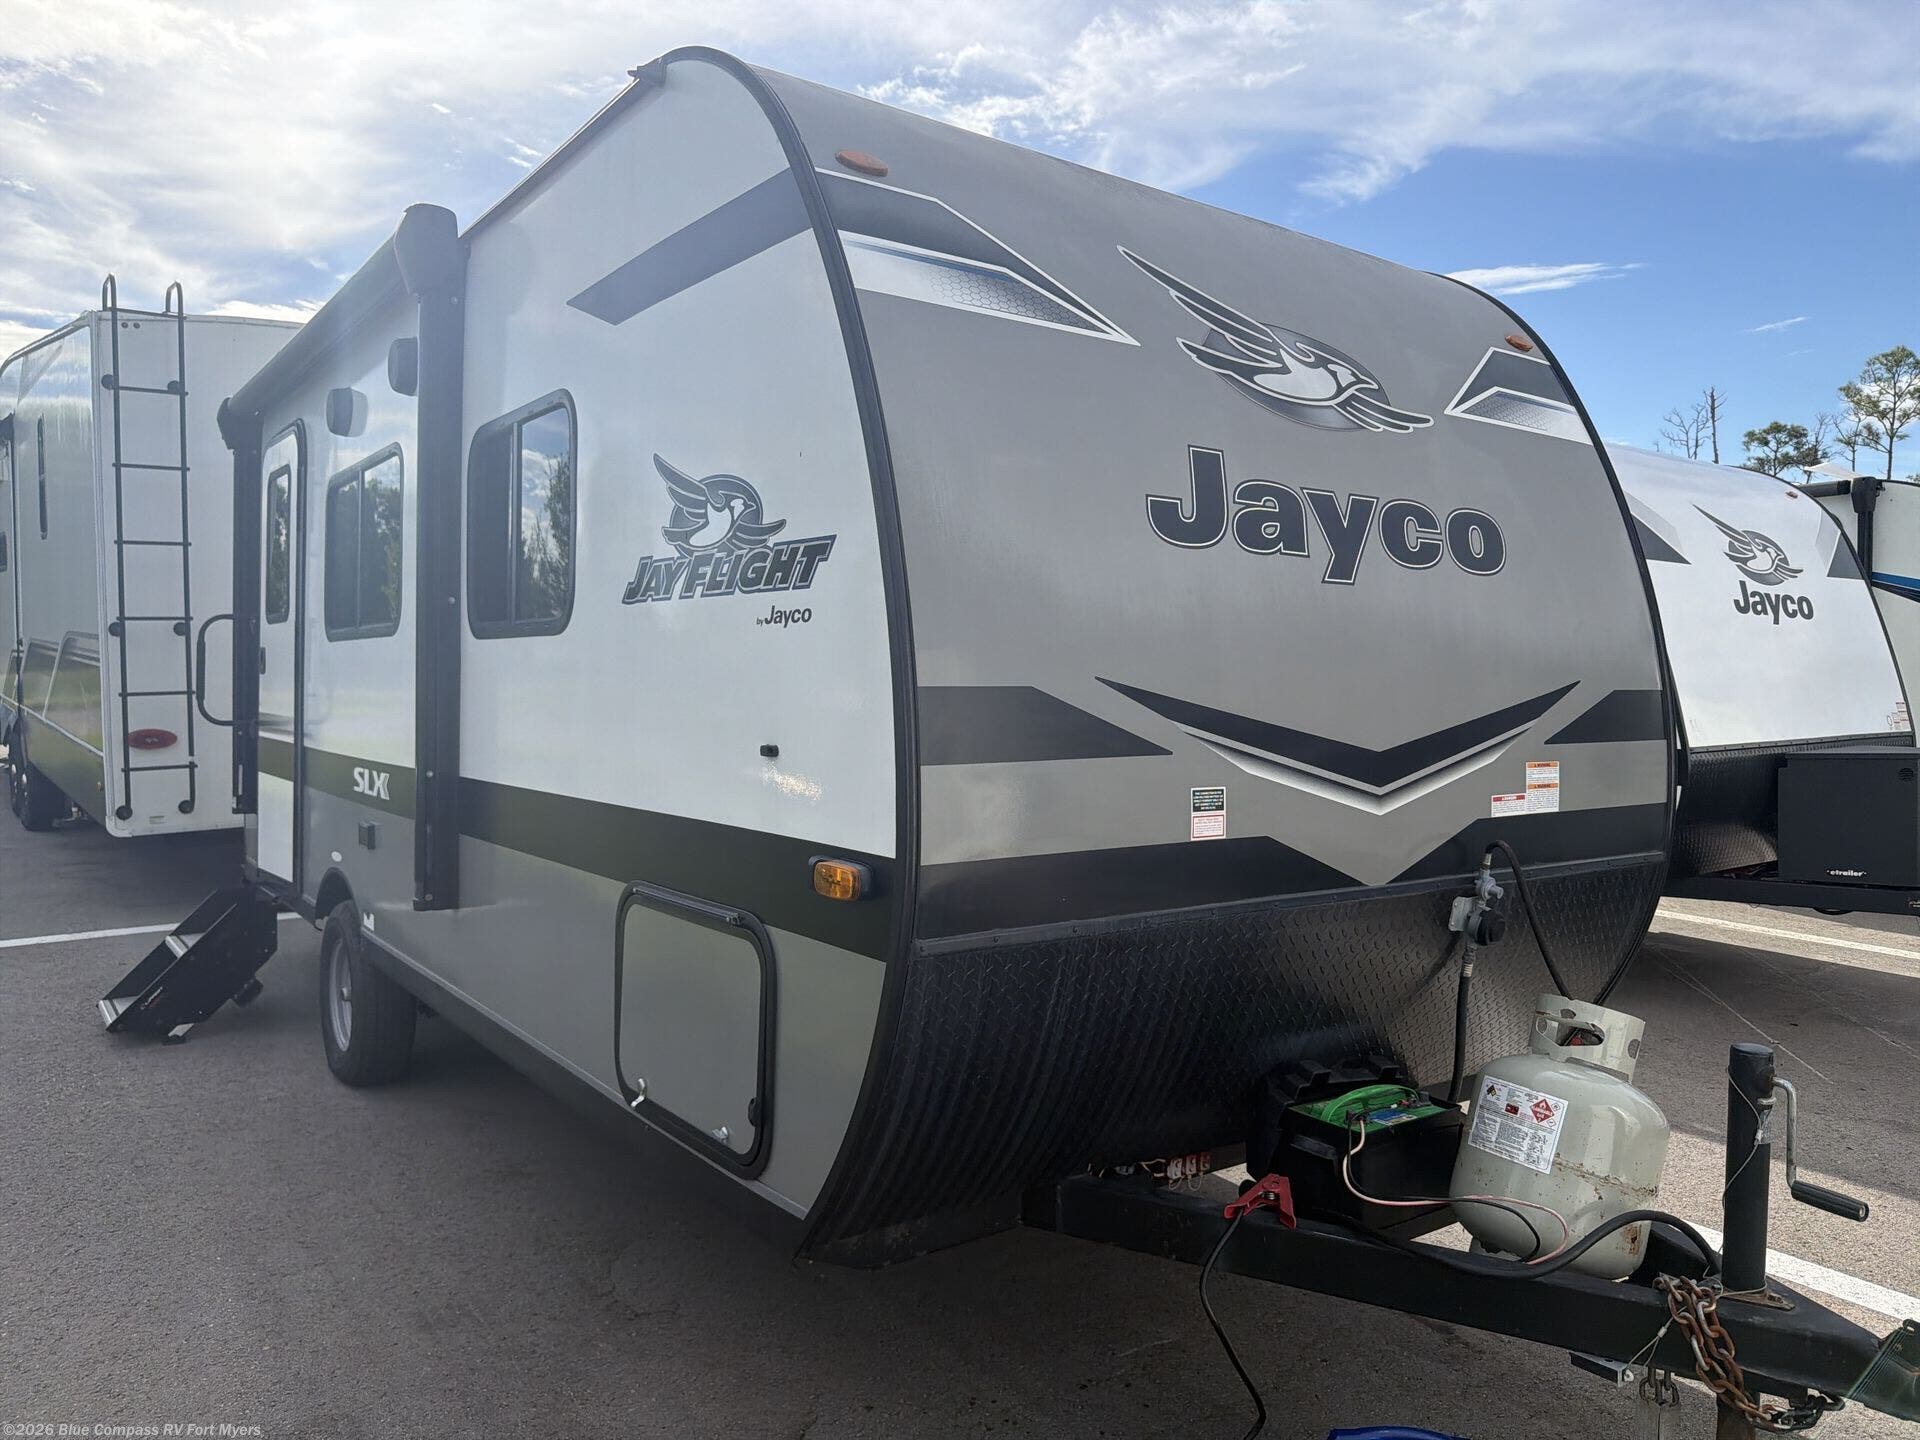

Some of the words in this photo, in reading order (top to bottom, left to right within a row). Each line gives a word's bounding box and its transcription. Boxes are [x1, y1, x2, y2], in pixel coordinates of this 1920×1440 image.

[1145, 444, 1507, 586] Jayco
[756, 617, 764, 627] by
[764, 605, 812, 628] Jayco
[1733, 580, 1815, 625] Jayco
[353, 766, 390, 801] SLX
[1829, 869, 1863, 877] etrailer
